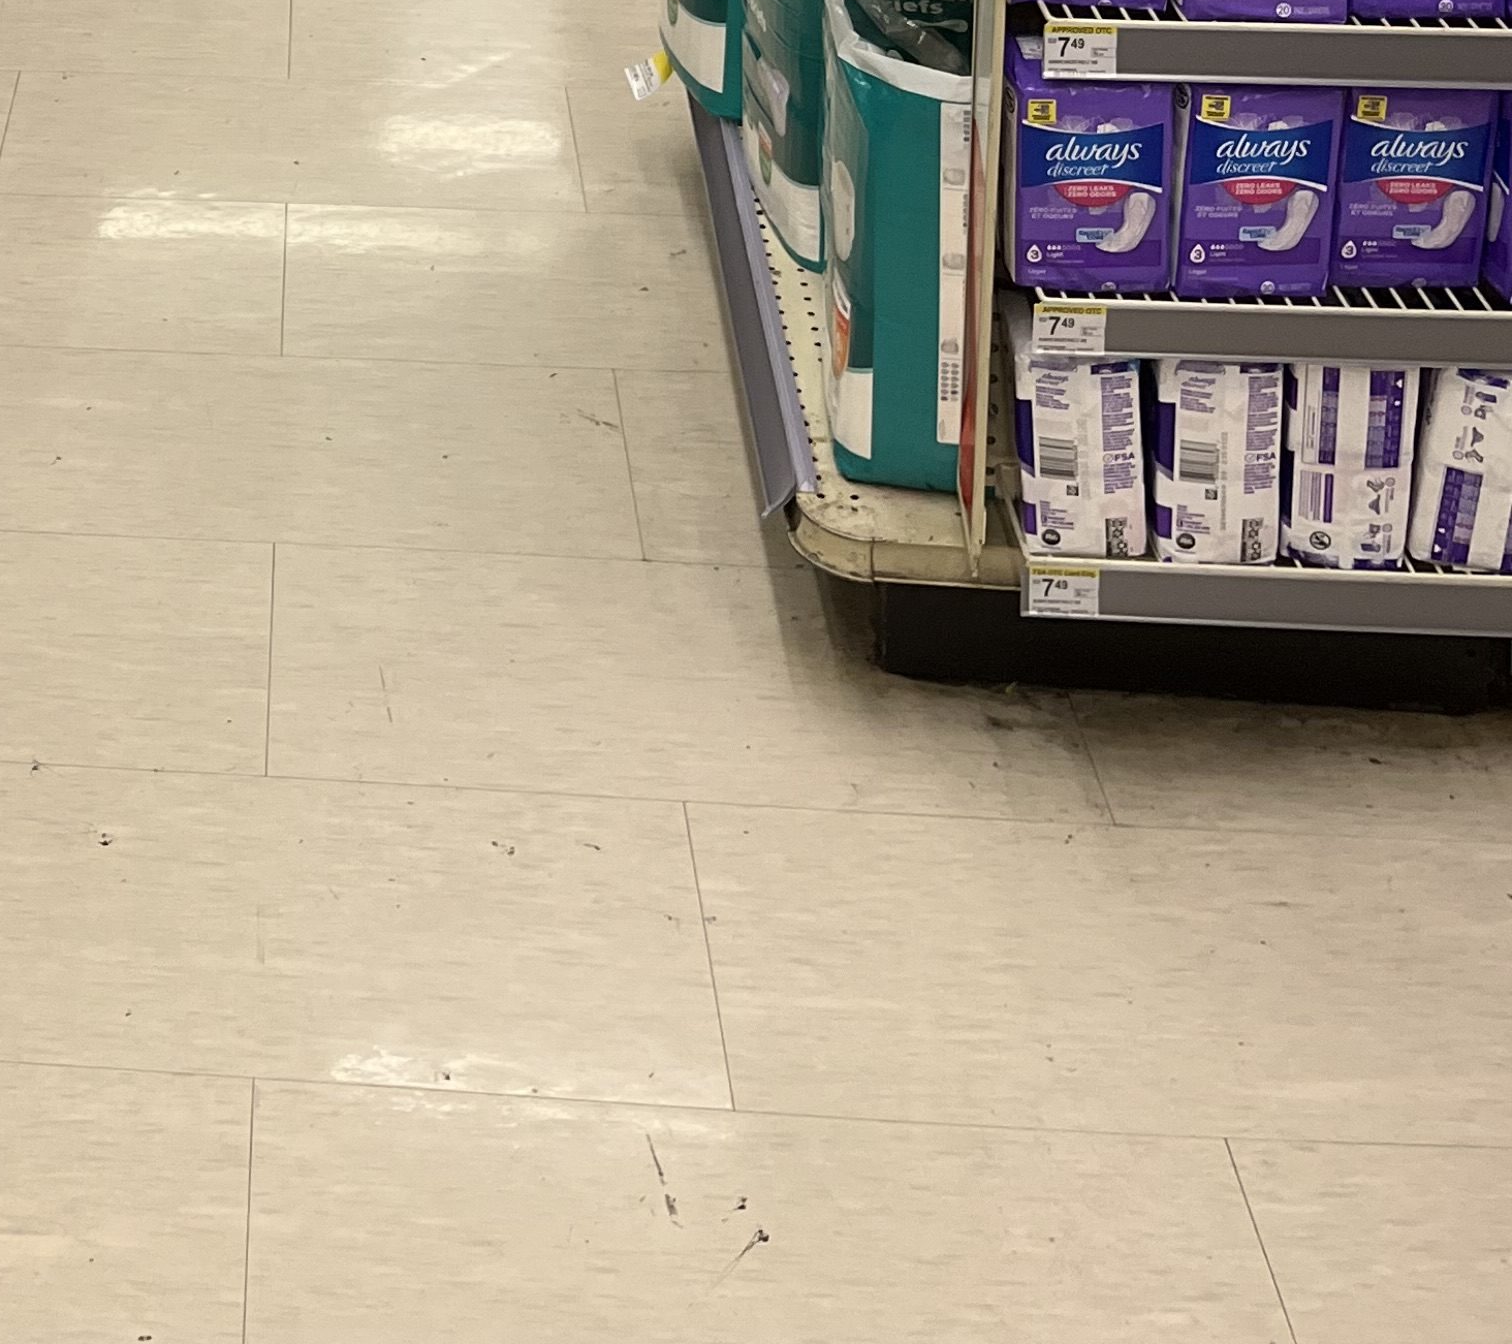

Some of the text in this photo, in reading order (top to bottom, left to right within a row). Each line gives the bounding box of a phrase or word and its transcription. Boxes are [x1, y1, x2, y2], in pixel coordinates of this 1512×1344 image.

[1051, 25, 1113, 34] APPROVED OTC
[1045, 135, 1143, 169] always
[1216, 133, 1311, 166] always
[1370, 132, 1470, 167] always
[1046, 162, 1109, 177] discreet
[1216, 158, 1277, 175] discreet
[1371, 159, 1434, 175] discreet
[1114, 452, 1136, 463] FSA
